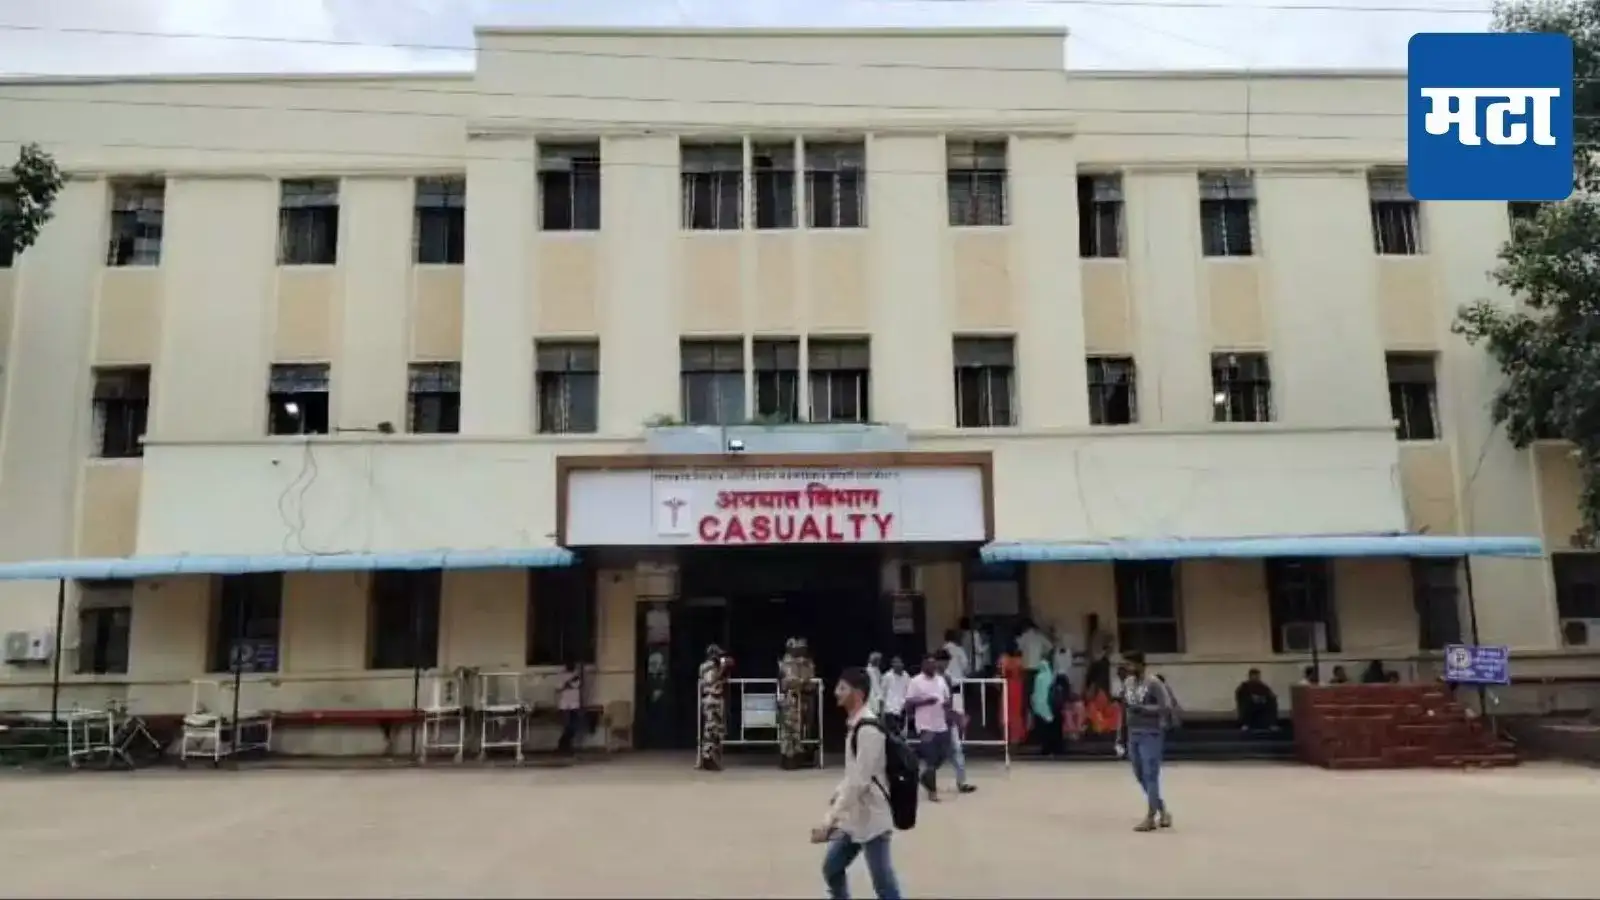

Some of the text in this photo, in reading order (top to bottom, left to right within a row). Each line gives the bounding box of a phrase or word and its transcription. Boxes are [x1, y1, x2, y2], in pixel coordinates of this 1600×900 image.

[716, 482, 880, 509] अपघात विभाग
[698, 513, 894, 541] CASUALTY
